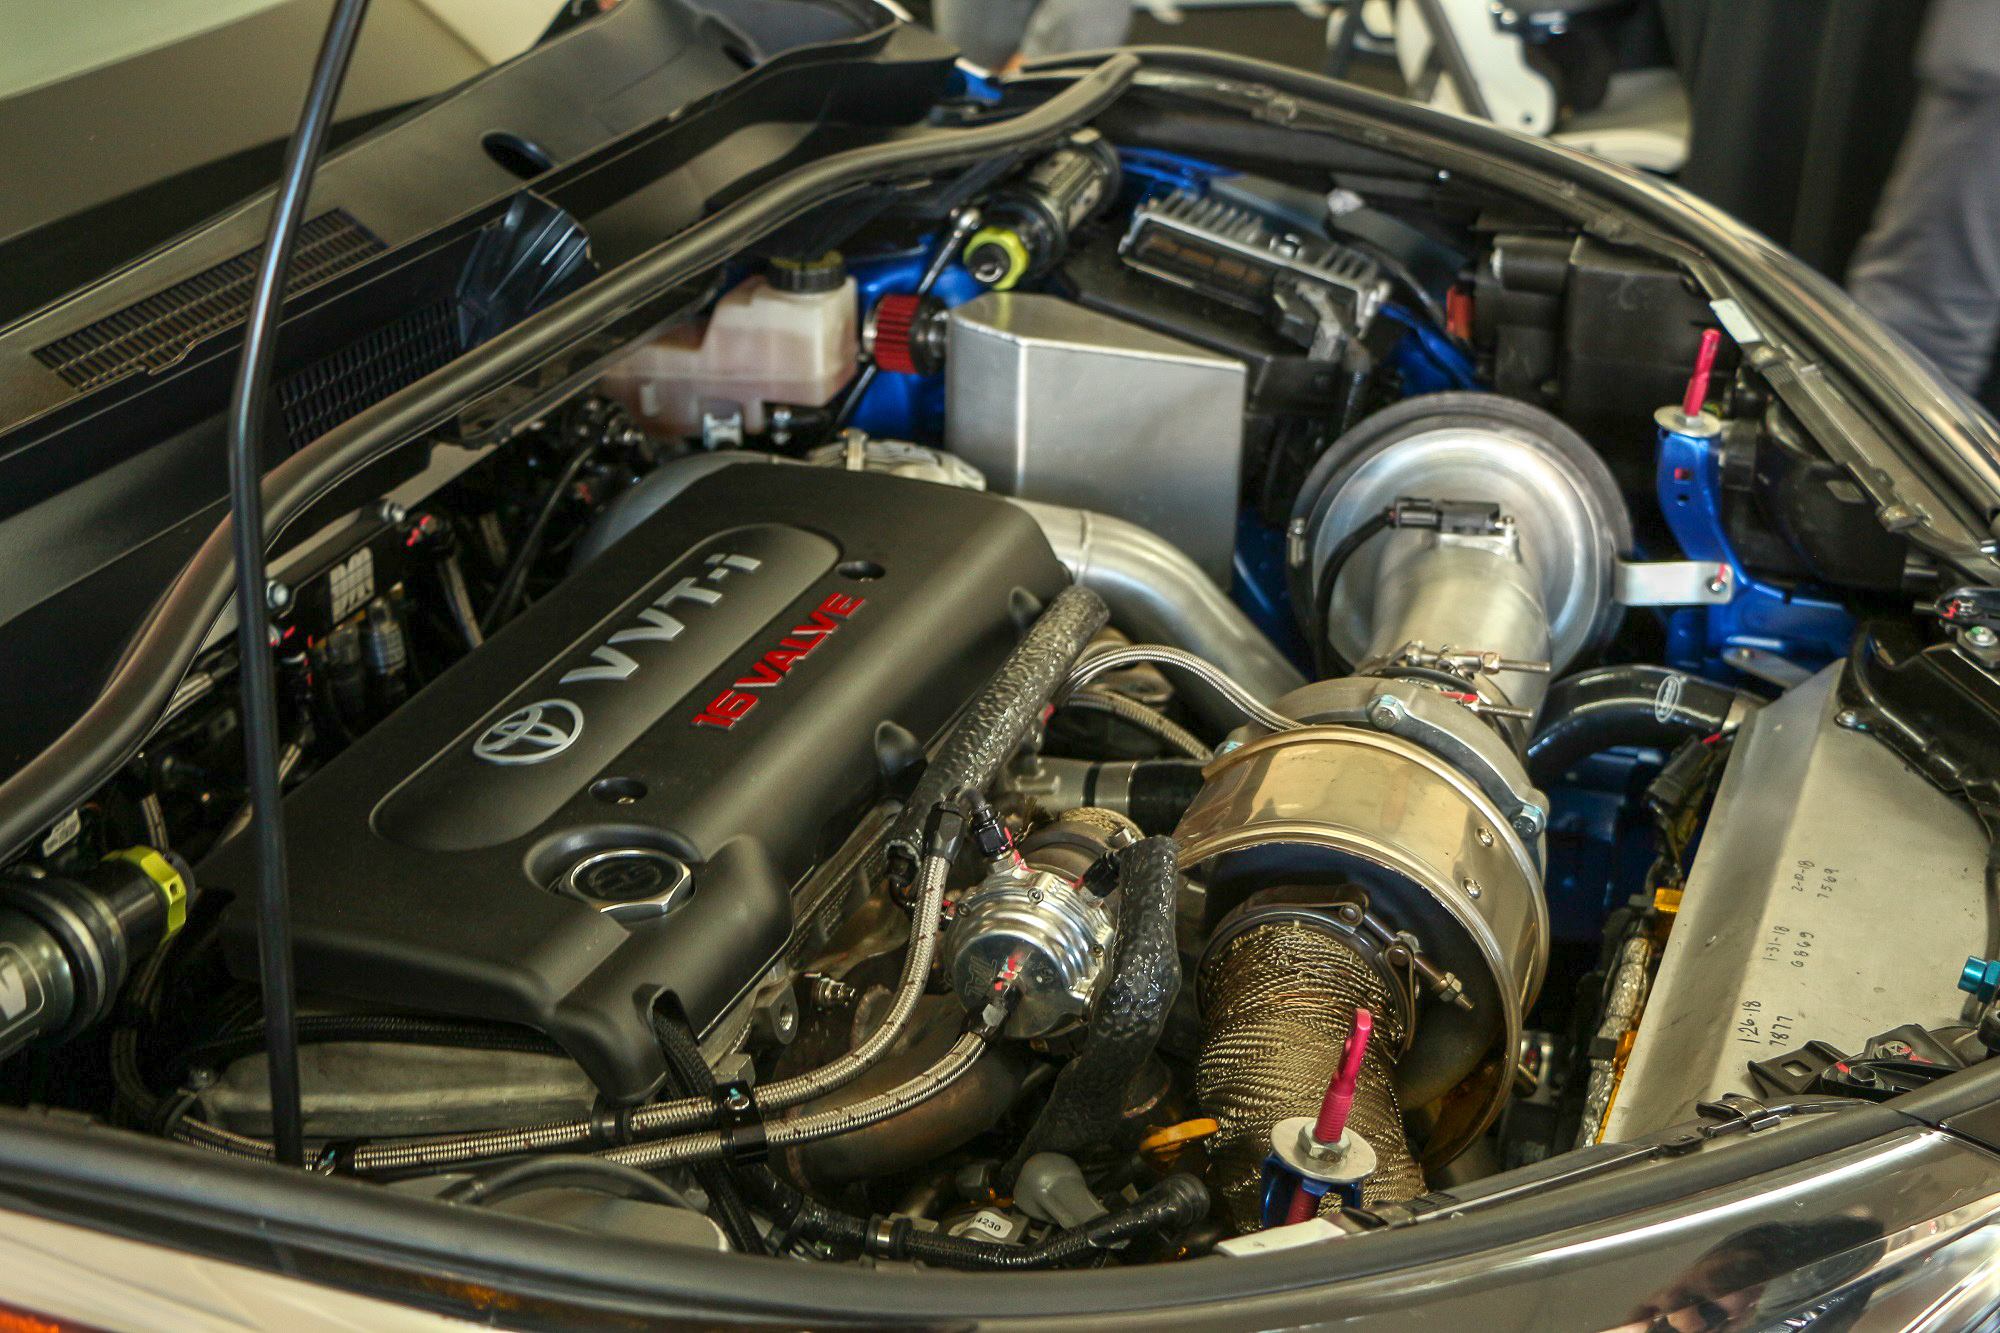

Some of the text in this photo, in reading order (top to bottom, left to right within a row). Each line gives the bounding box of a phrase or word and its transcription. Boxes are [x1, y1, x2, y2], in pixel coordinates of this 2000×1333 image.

[558, 553, 762, 685] VVT-i
[1817, 868, 1840, 899] 7569
[1769, 1015, 1794, 1047] 7877
